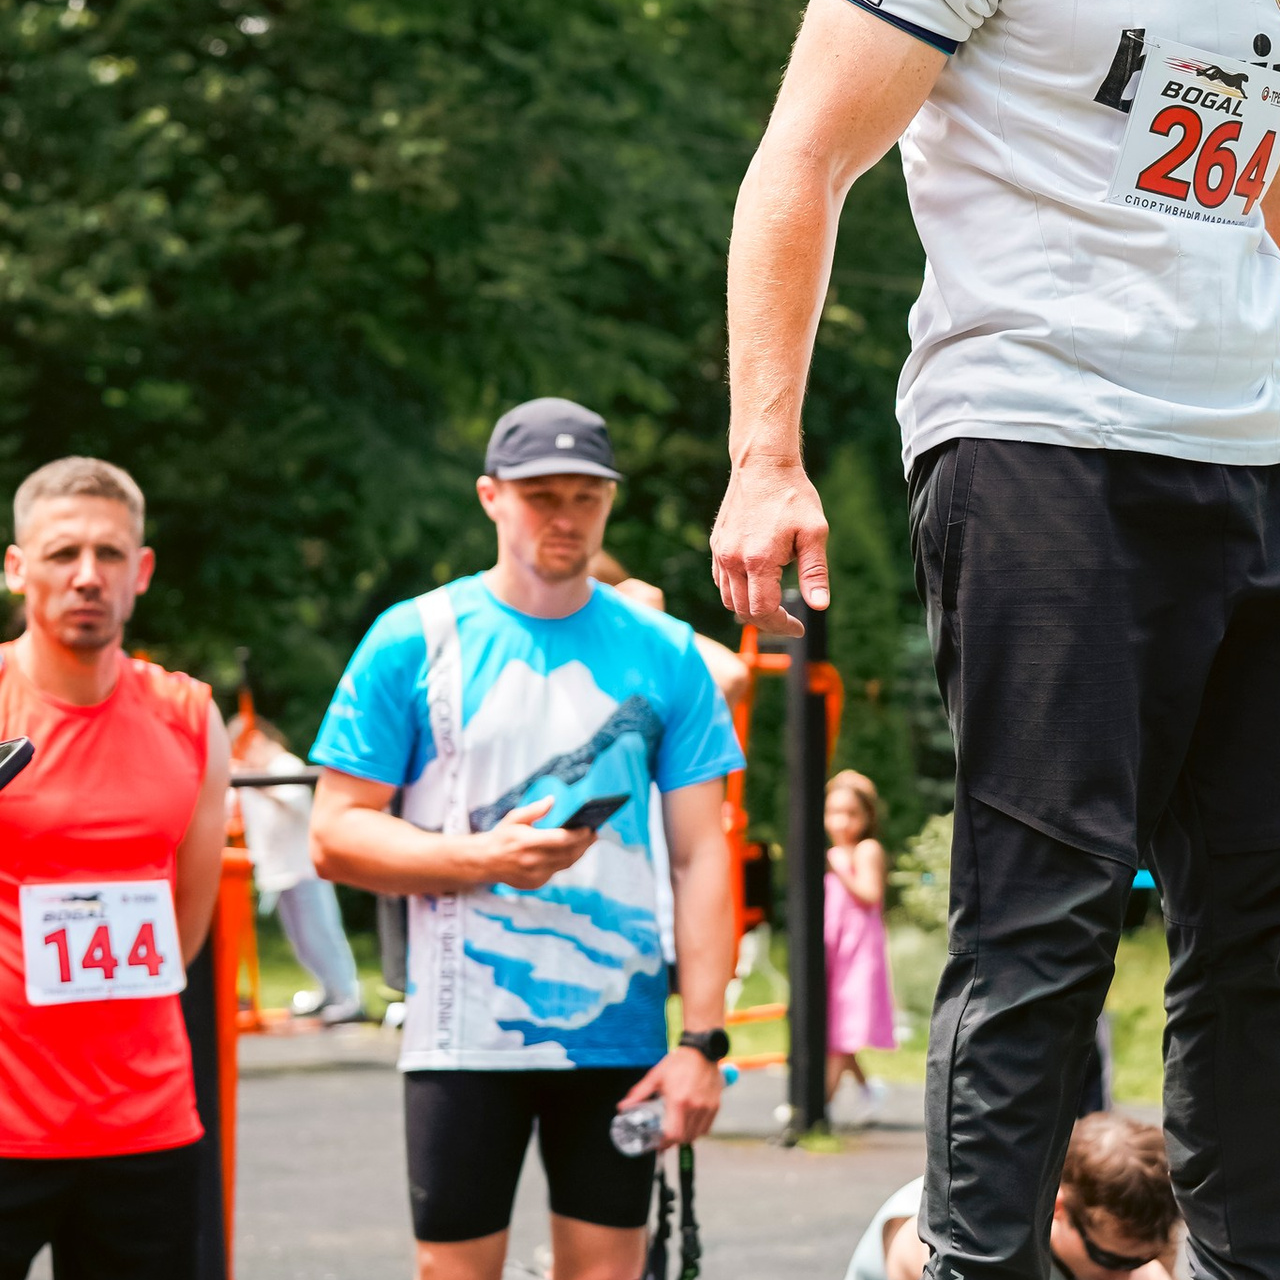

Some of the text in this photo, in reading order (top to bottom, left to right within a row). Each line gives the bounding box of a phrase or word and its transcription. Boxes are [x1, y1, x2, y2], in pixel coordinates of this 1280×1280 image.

[1161, 80, 1243, 117] BOGAL
[1135, 104, 1277, 215] 264
[1124, 194, 1201, 221] СПОРТИВНЫЙ
[44, 923, 164, 982] 144
